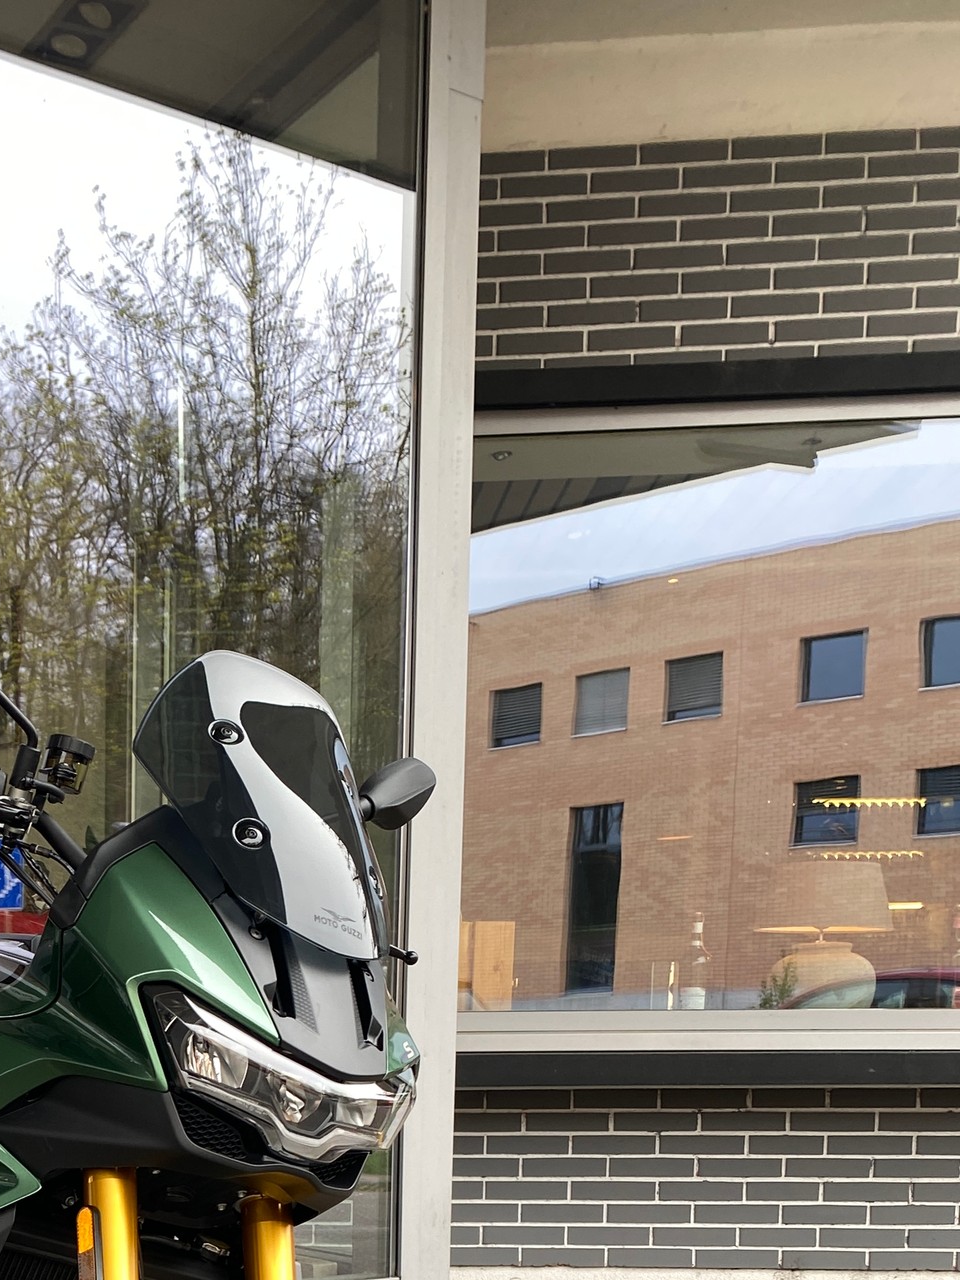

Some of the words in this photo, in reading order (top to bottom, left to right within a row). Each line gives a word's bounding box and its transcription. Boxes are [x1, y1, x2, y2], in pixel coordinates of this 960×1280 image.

[313, 914, 339, 929] MOTO
[341, 923, 363, 940] GUZZI
[403, 1041, 416, 1059] S
